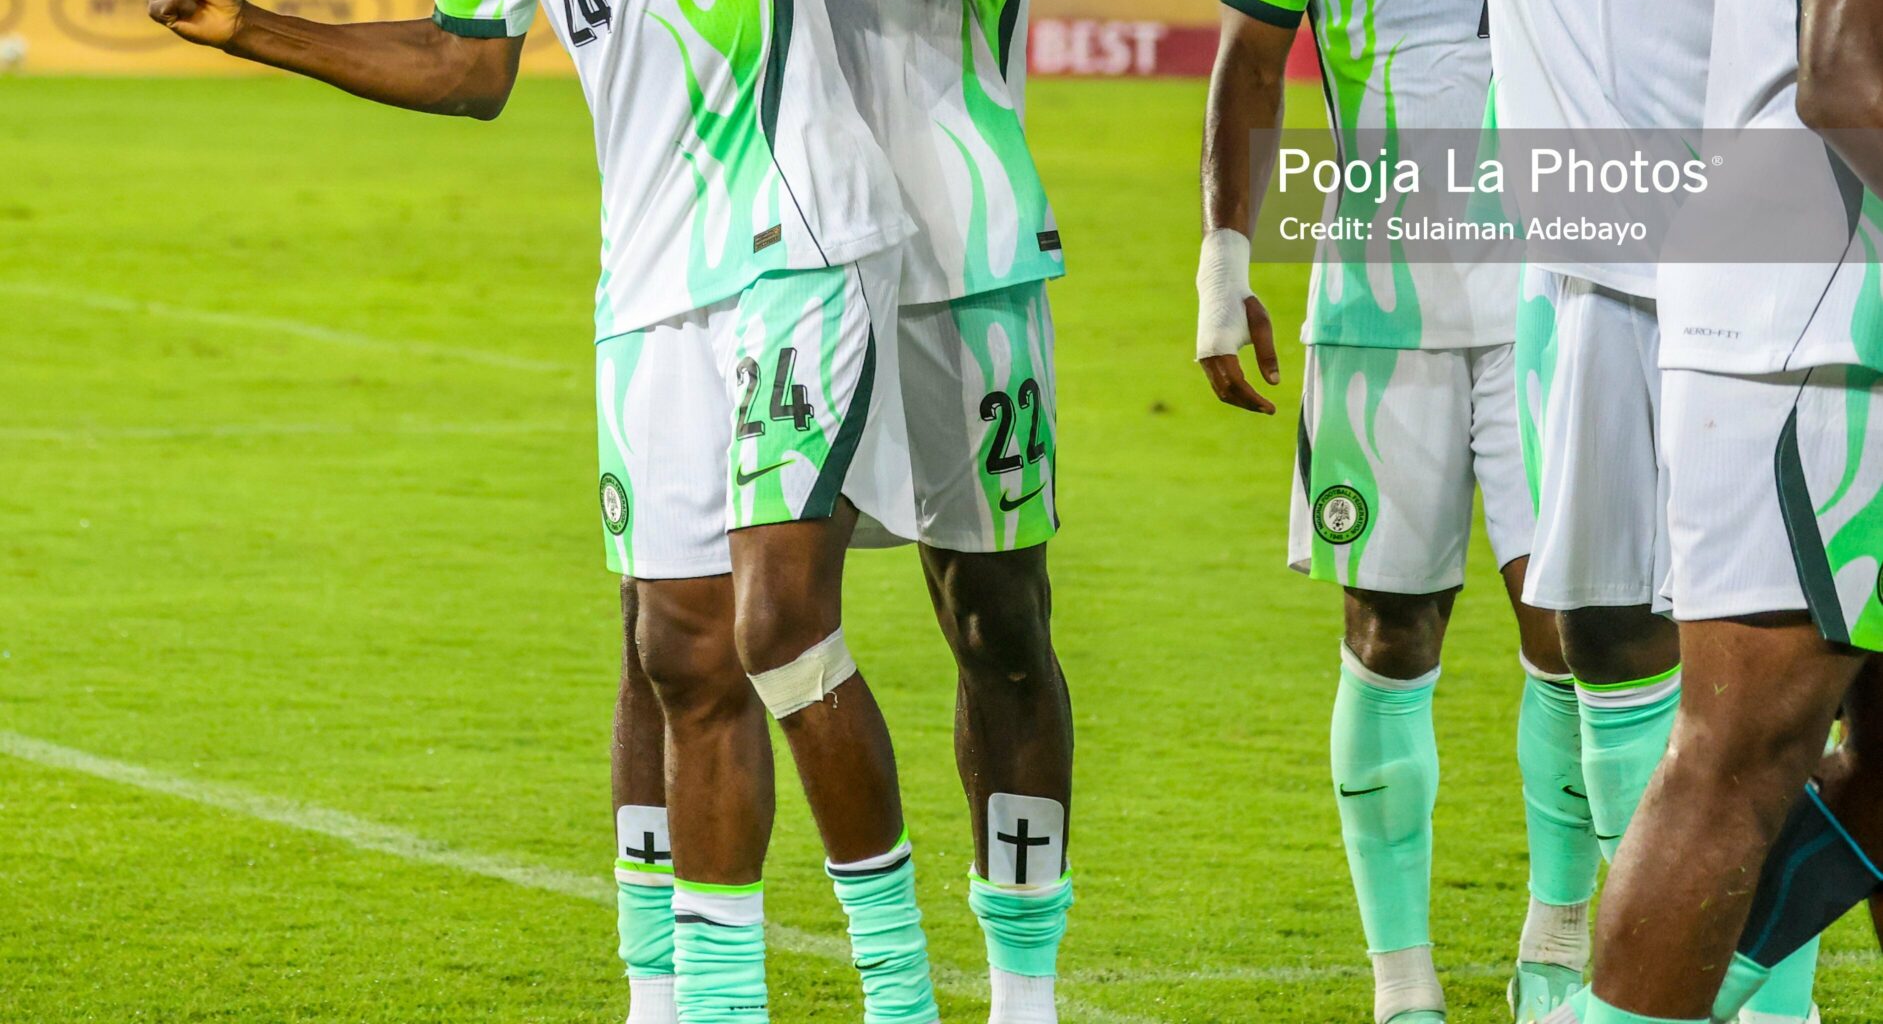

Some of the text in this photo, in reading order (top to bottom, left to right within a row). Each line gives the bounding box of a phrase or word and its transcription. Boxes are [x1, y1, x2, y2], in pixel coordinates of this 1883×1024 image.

[1030, 19, 1162, 74] BEST
[736, 347, 815, 441] 24
[979, 378, 1046, 475] 22
